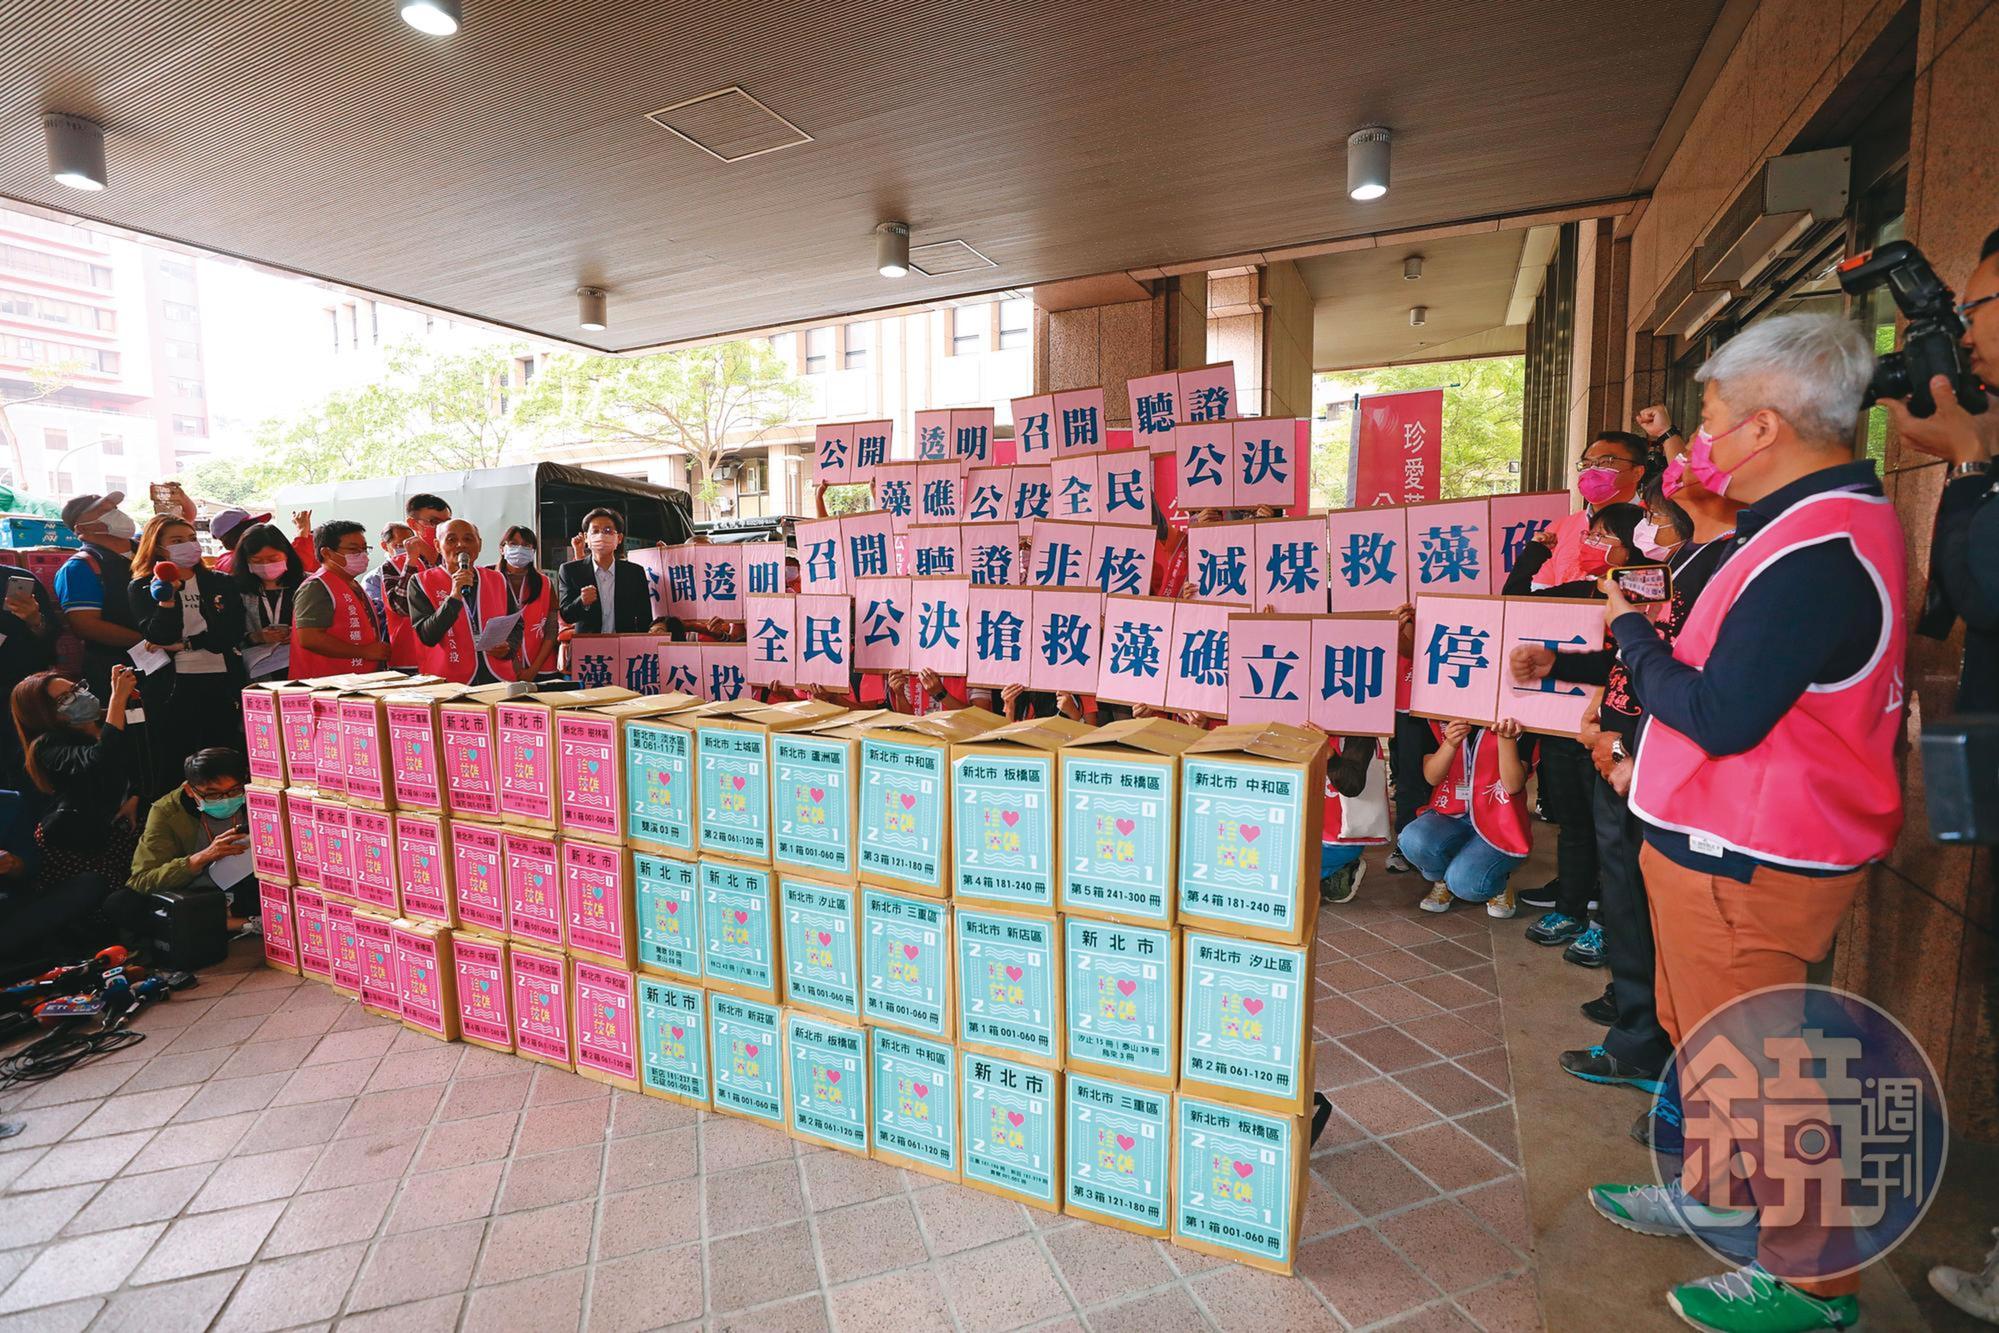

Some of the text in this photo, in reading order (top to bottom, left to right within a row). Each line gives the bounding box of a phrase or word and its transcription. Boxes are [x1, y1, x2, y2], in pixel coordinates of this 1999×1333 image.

[919, 424, 988, 461] 透明
[1019, 407, 1099, 453] 召開
[820, 435, 886, 470] 公開
[1185, 440, 1288, 487] 公決
[881, 479, 955, 516] 藻礁
[971, 482, 1052, 520] 公投
[1059, 469, 1145, 516] 全民
[805, 532, 886, 583] 召開
[916, 545, 1013, 585] 聽證
[1036, 543, 1145, 595] 非核
[1197, 542, 1319, 597] 減煤
[864, 598, 960, 650] 公決
[977, 610, 1092, 666] 搶救
[753, 615, 843, 664] 全民
[1110, 621, 1229, 686] 藻礁
[578, 653, 660, 695] 藻礁
[1240, 644, 1384, 705] 立即
[1424, 623, 1588, 697] 停工
[666, 664, 745, 701] 公投
[446, 716, 484, 730] 新北市
[504, 712, 542, 729] 新北市
[633, 729, 656, 741] 新北市
[705, 737, 760, 753] 新北市 土城區
[780, 746, 806, 759] 新北市
[870, 749, 935, 770] 新北市 中和區
[963, 765, 1040, 782] 新北市 板橋區
[1075, 770, 1160, 790] 新北市 板橋區
[1195, 772, 1290, 796] 新北市 中和區
[640, 861, 691, 884] 新北市
[709, 871, 758, 890] 新北市
[788, 890, 846, 910] 新北市 汐止區
[871, 900, 937, 923] 新北市 三重區
[966, 921, 1042, 942] 新北市 新店區
[1082, 930, 1154, 954] 新北市
[1200, 946, 1292, 973] 新北市 汐止區
[647, 987, 695, 1011] 新北市
[718, 1003, 774, 1025] 新北市 新莊區
[795, 1027, 857, 1050] 新北市 板橋區
[881, 1038, 946, 1065] 新北市 中和區
[975, 1062, 1043, 1094] 新北市
[1078, 1086, 1159, 1115] 新北市 三重區
[1190, 1110, 1280, 1141] 新北市 板橋區
